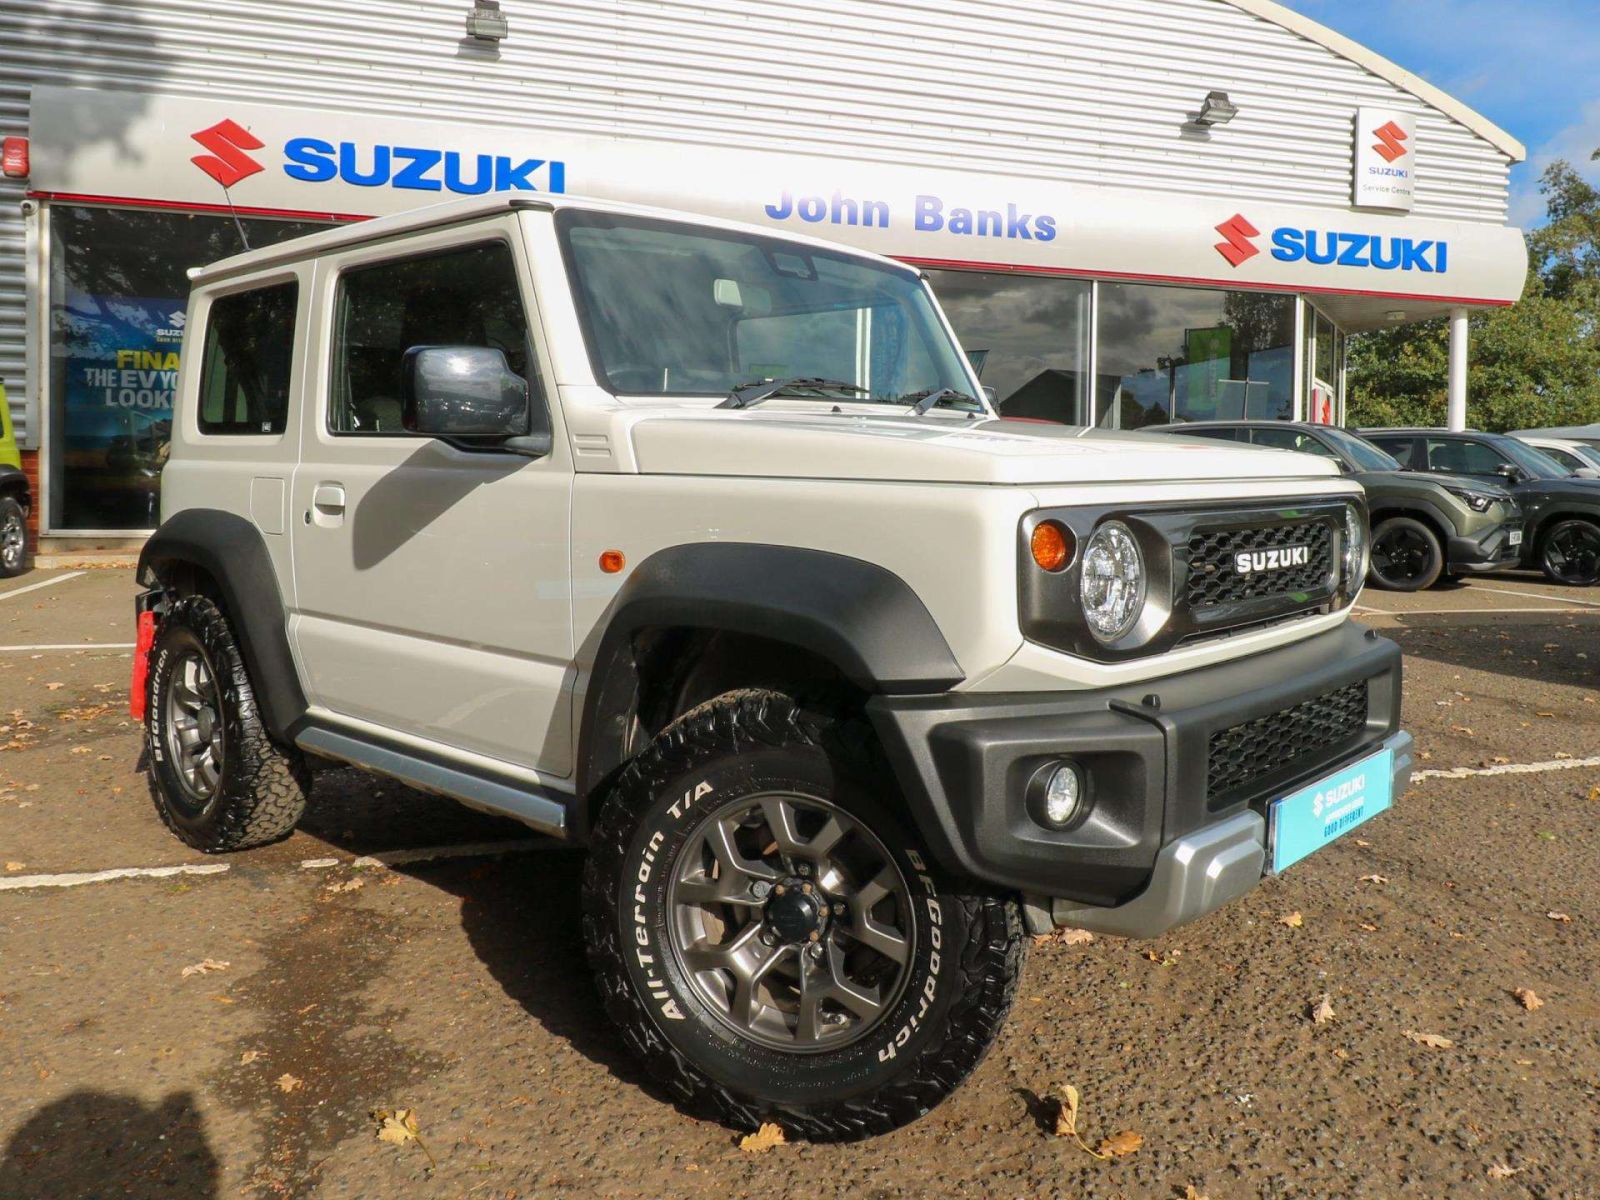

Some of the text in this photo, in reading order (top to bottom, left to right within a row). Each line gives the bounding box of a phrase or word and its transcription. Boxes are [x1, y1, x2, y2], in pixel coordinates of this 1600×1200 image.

[283, 137, 565, 195] SUZUKI
[1369, 166, 1408, 178] SUZUKI
[1363, 183, 1411, 196] Service Centre
[764, 190, 1057, 242] John Banks
[1270, 227, 1448, 273] SUZUKI
[84, 368, 118, 387] THE
[121, 370, 157, 388] EV
[1236, 546, 1308, 573] SUZUKI
[151, 649, 168, 762] BFGoodrich
[1326, 774, 1365, 807] SUZUKI
[634, 780, 713, 1021] All-Terrain T/A
[878, 849, 943, 1063] BFGoodrich
